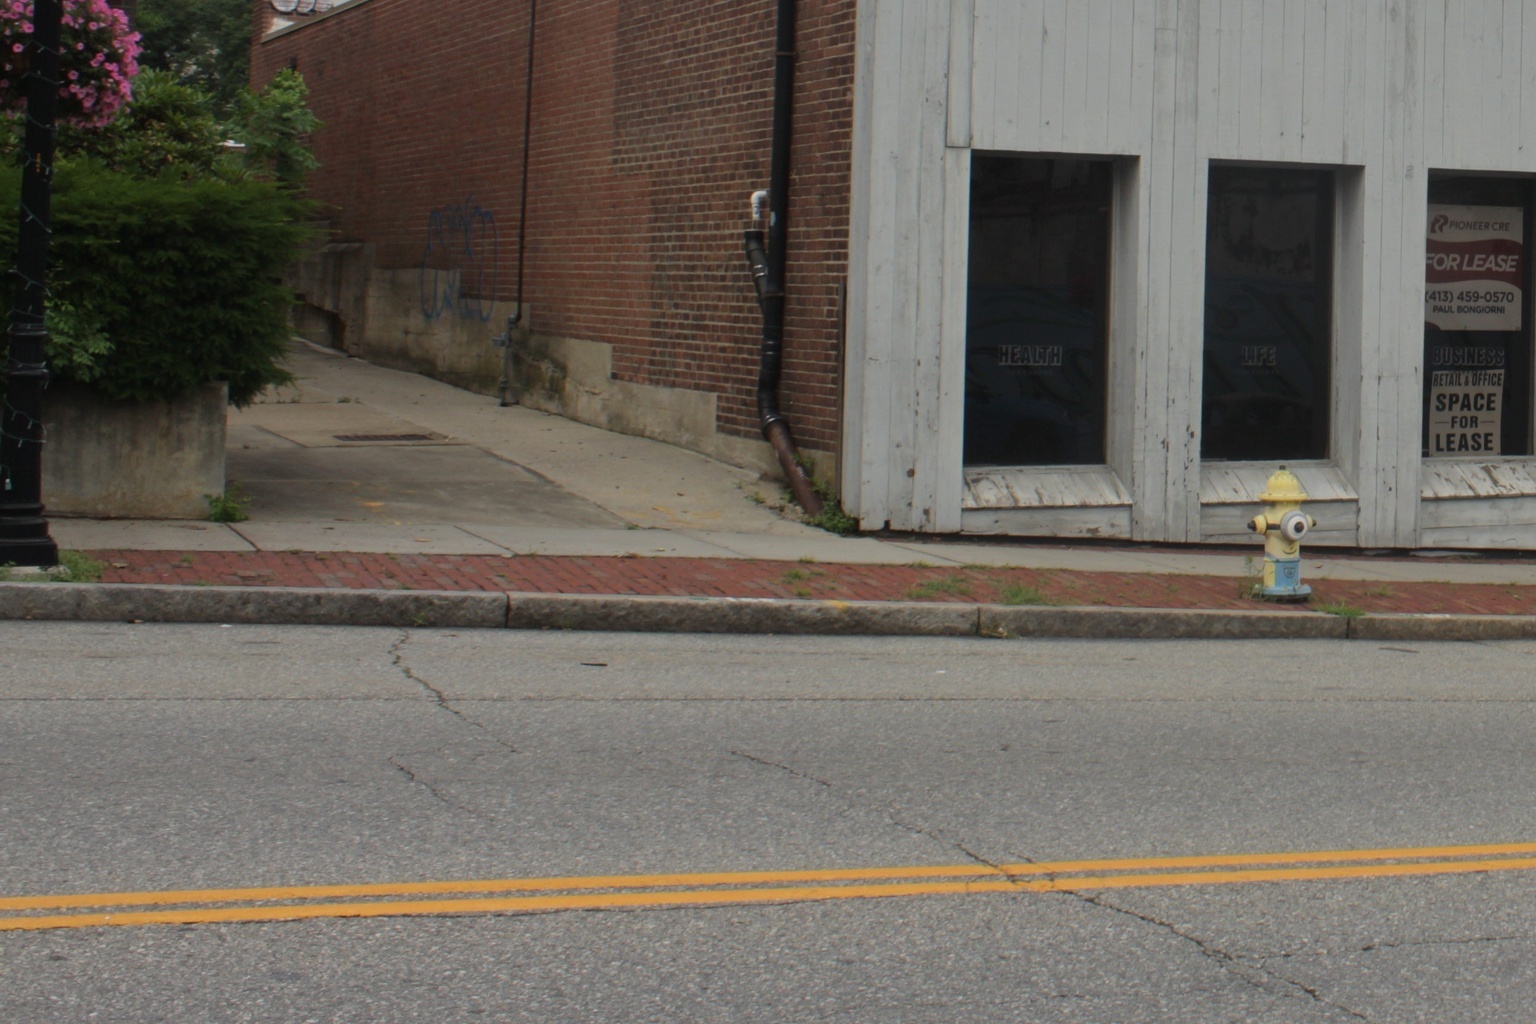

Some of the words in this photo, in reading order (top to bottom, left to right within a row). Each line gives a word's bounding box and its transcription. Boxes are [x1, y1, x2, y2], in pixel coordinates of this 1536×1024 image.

[1449, 220, 1490, 231] PIONEER
[1491, 221, 1511, 232] CRE
[1462, 253, 1520, 273] LEASE
[1425, 290, 1454, 304] (413)
[1456, 291, 1515, 304] 459-0570
[1432, 305, 1455, 314] PAUL
[1456, 305, 1506, 315] BONGIORNI
[998, 344, 1063, 367] HEALTH
[1241, 345, 1277, 367] LIFE
[1432, 346, 1505, 366] BUSINESS
[1433, 372, 1462, 387] RETAIL
[1464, 374, 1470, 387] &
[1471, 372, 1504, 387] OFFICE
[1435, 392, 1497, 412] SPACE
[1451, 415, 1479, 429] FOR
[1435, 432, 1494, 452] LEASE
